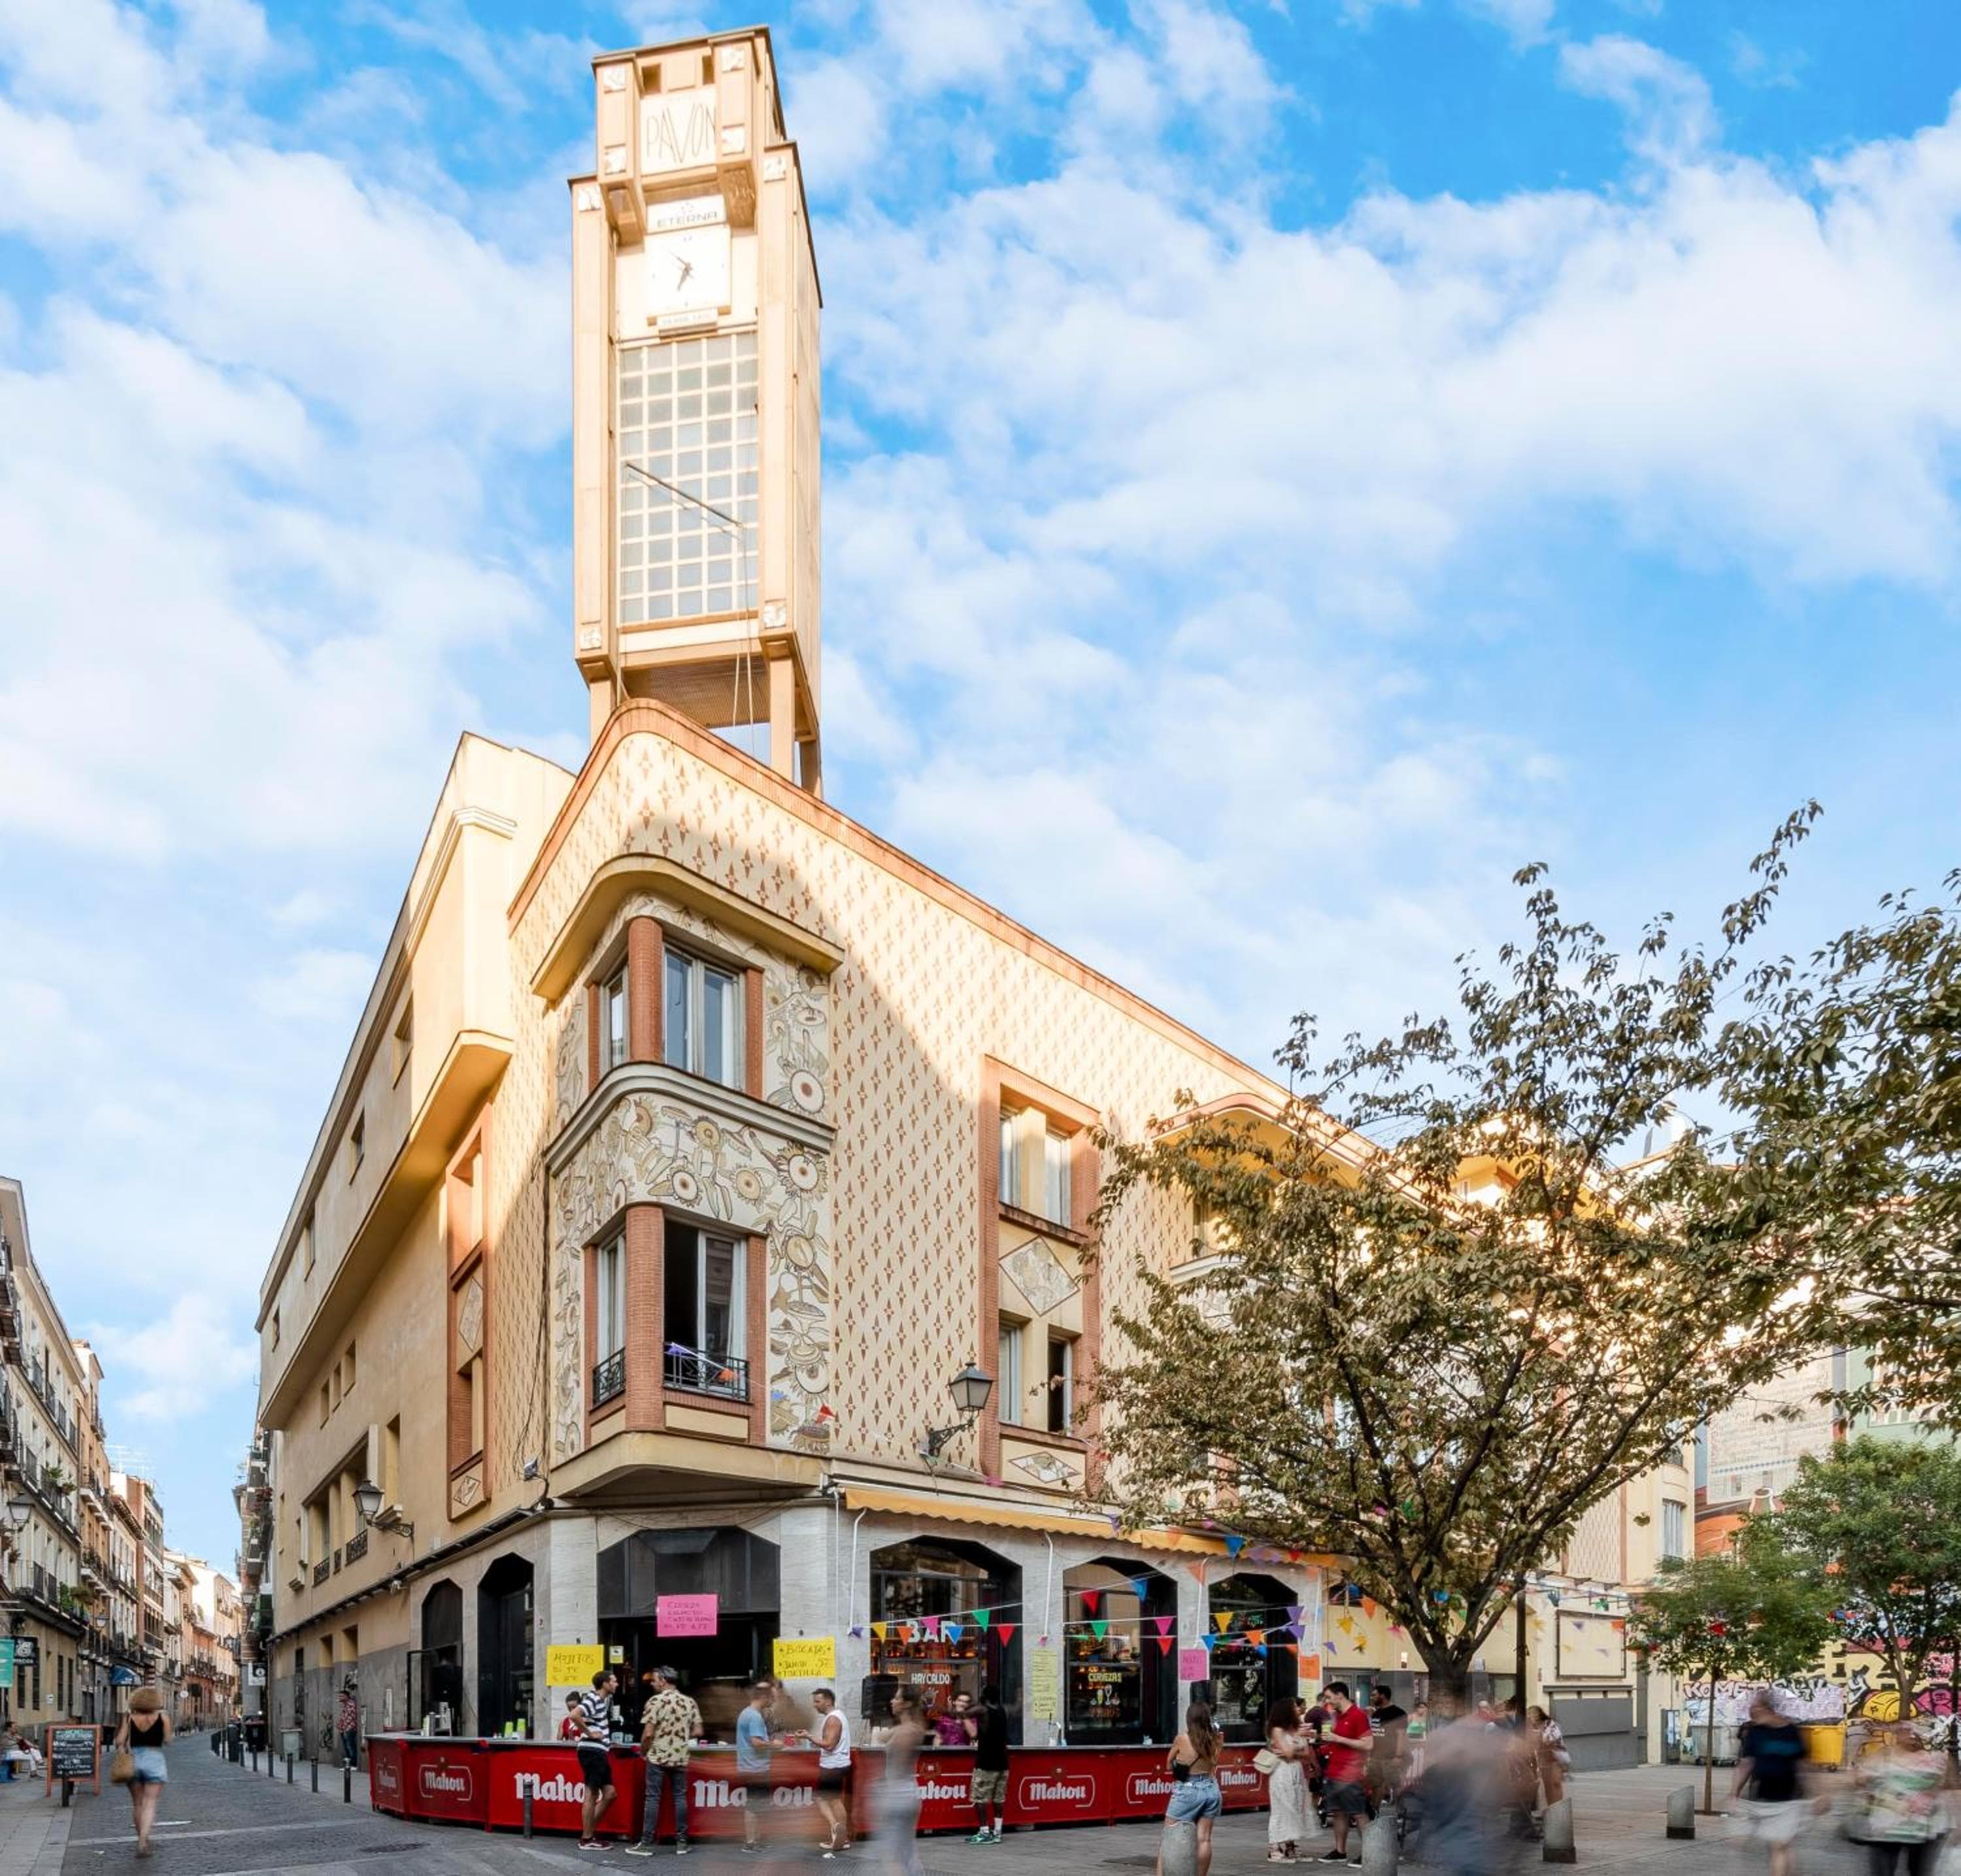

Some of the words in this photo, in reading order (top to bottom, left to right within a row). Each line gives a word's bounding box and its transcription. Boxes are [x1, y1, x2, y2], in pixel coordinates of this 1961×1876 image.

[657, 212, 718, 228] ETERNA
[905, 1620, 957, 1643] BAR
[911, 1673, 926, 1684] HAY
[926, 1673, 950, 1684] CALDO
[424, 1770, 465, 1792] Mahou
[514, 1772, 603, 1803] Maho
[1220, 1769, 1257, 1786] Mahou
[693, 1780, 814, 1808] Maou
[916, 1780, 967, 1800] ahou
[1030, 1782, 1087, 1800] Mahou
